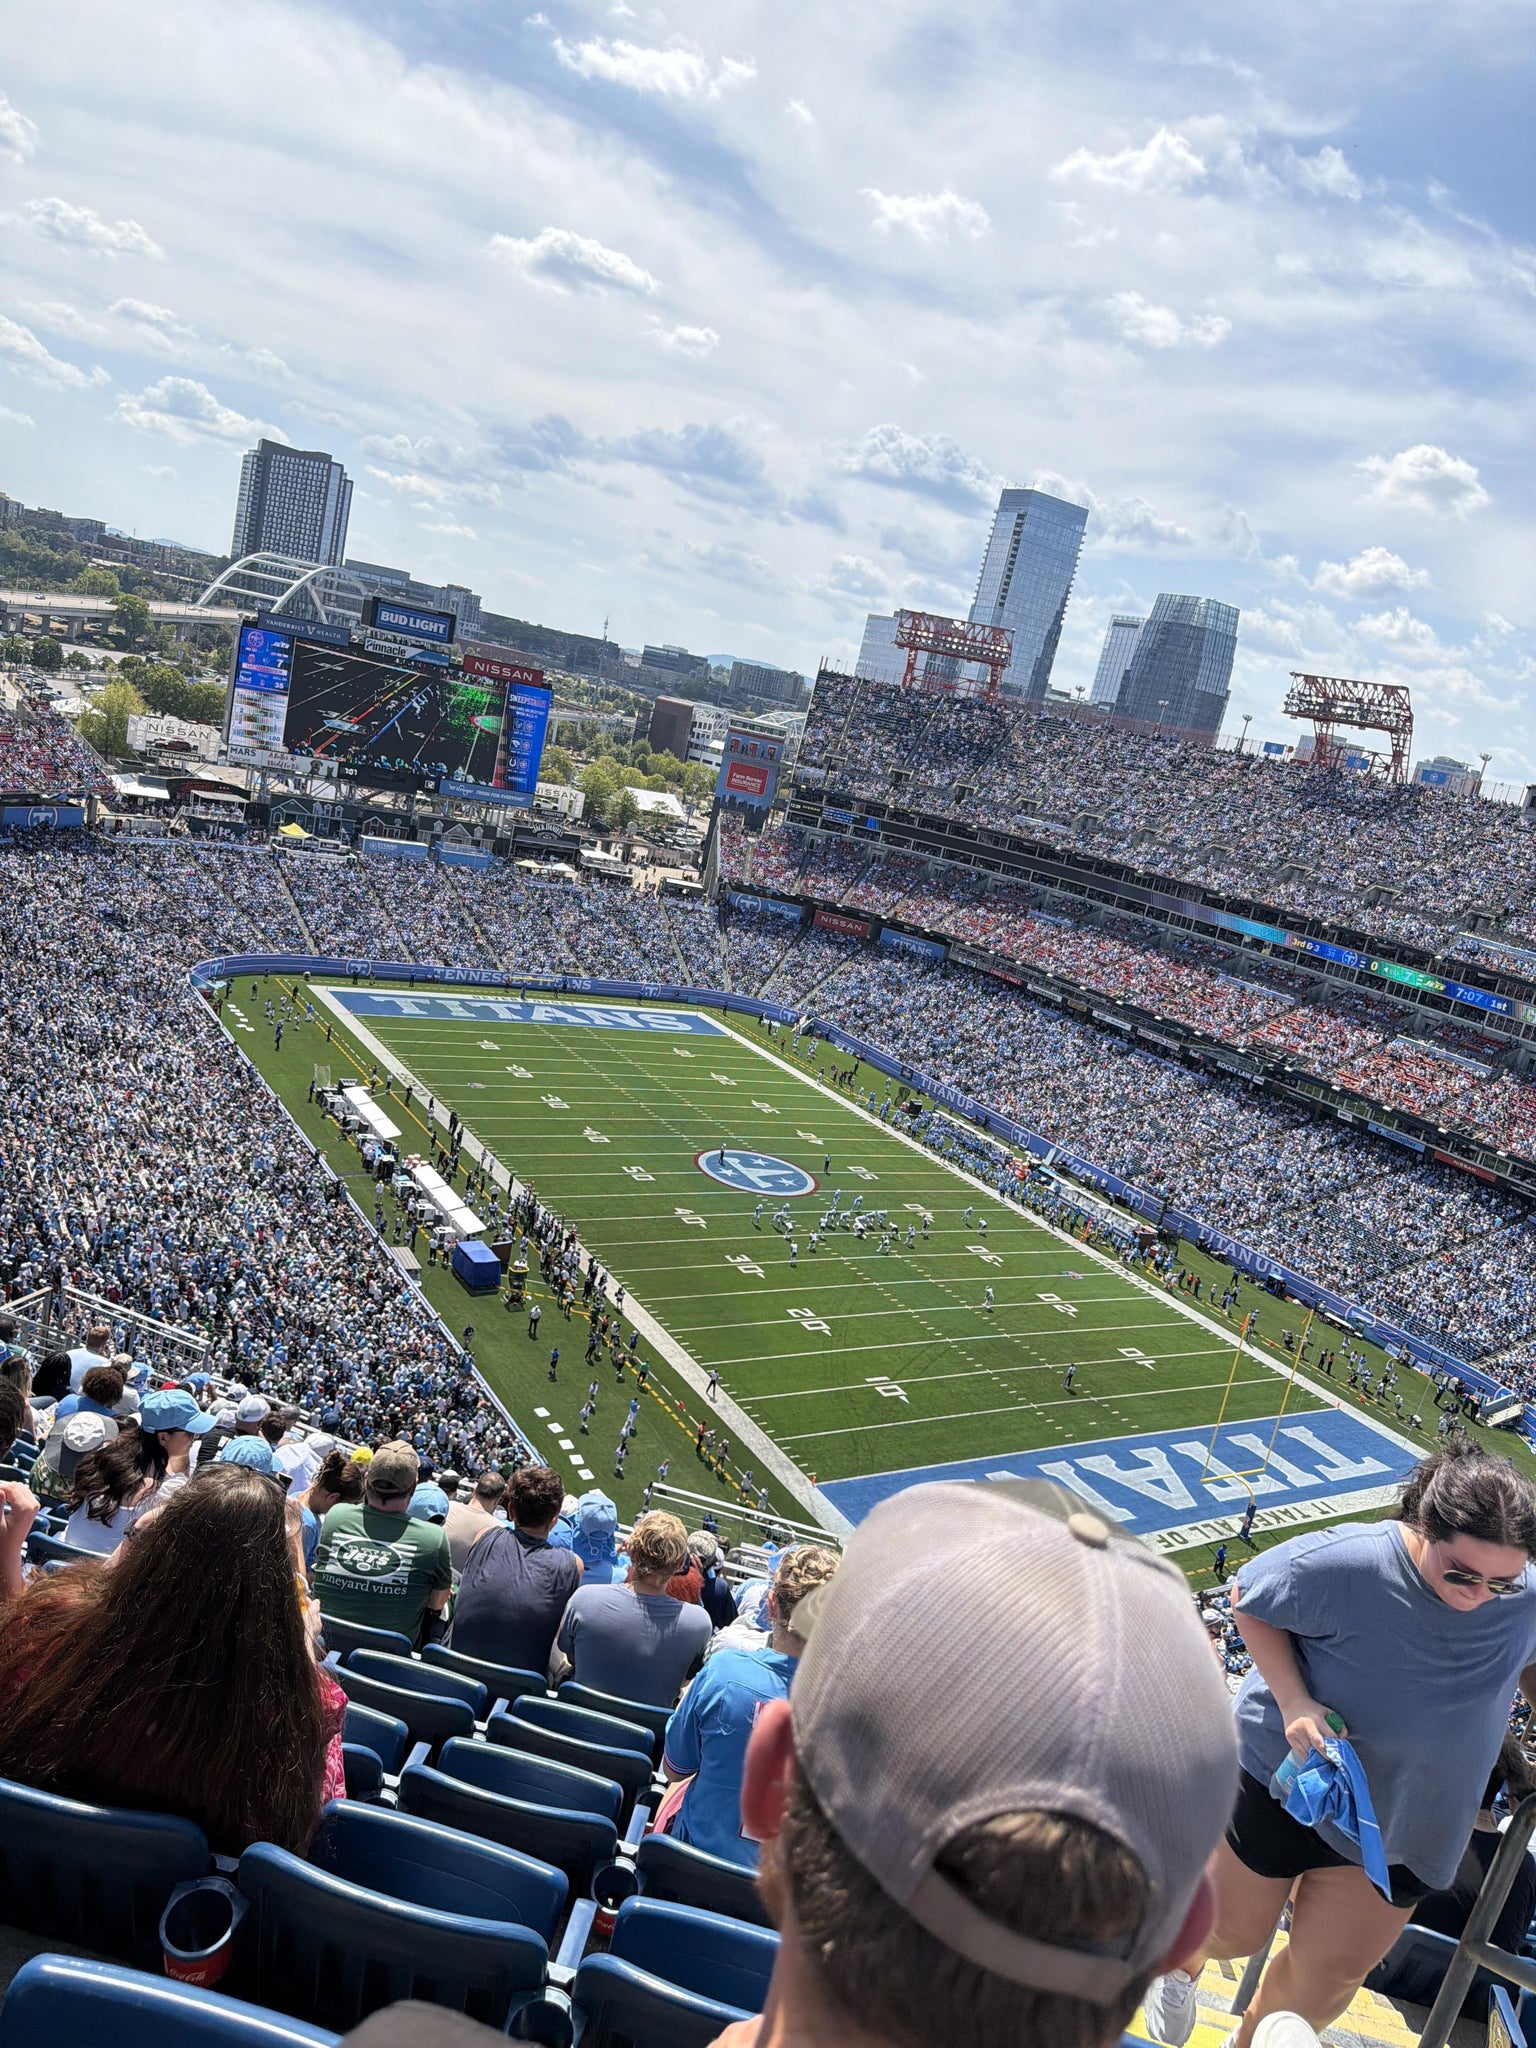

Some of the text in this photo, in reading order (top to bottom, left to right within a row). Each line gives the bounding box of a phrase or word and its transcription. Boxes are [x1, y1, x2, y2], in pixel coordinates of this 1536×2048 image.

[266, 618, 305, 632] VANDERBILT
[316, 630, 341, 639] HEALTH
[380, 610, 446, 634] BUD LIGHT
[365, 639, 407, 657] Pinnacle
[474, 661, 534, 682] NISSAN
[148, 723, 209, 740] NISSAN
[161, 752, 199, 761] PATHFINDER
[230, 746, 257, 757] MARS
[730, 778, 762, 789] INSURANCE
[732, 772, 763, 783] Farm Bureau
[541, 810, 565, 818] FRONTIER
[532, 822, 546, 834] JACK
[820, 915, 862, 931] NISSAN
[891, 938, 933, 957] TITANS
[433, 967, 533, 986] TENNESSEE
[1292, 937, 1306, 949] 3rd
[1314, 944, 1321, 953] 3
[1370, 961, 1379, 972] 0
[1404, 972, 1412, 982] 7
[1455, 987, 1485, 1003] 7:07
[1490, 999, 1509, 1011] 1st
[367, 994, 693, 1032] TITANS
[1216, 1061, 1239, 1074] ROCKY
[1237, 1069, 1253, 1080] LAW
[920, 1075, 974, 1112] TITAN UP
[621, 1165, 656, 1182] 50
[1453, 1159, 1478, 1173] NISSAN
[1197, 1224, 1283, 1277] TITAN UP
[724, 1254, 766, 1280] 30
[785, 1307, 832, 1337] 20
[864, 1376, 910, 1404] 10
[1156, 1500, 1337, 1550] IT TAKES ALL OF
[343, 1548, 390, 1566] JETS
[322, 1573, 408, 1596] vineyard vines
